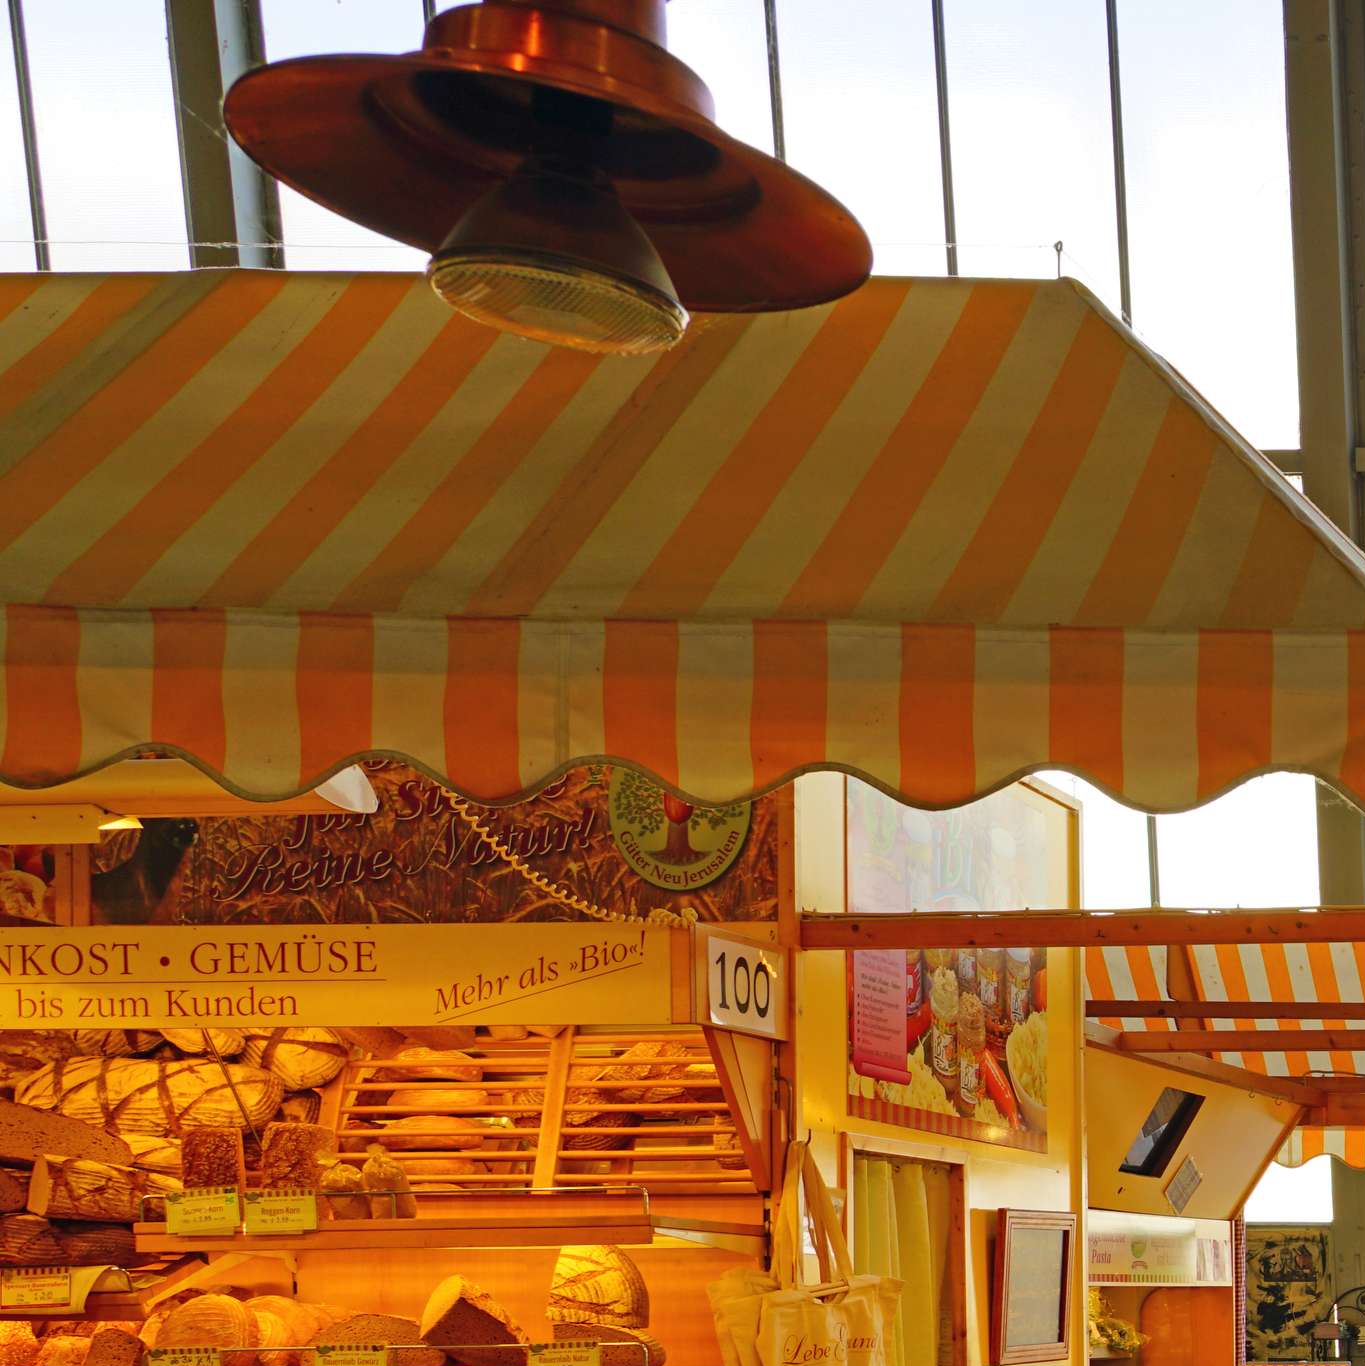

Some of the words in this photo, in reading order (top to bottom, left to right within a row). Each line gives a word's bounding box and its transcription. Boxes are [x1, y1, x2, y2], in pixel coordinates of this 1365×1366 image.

[211, 842, 394, 901] Reine
[403, 808, 596, 876] Natur!
[620, 831, 651, 871] Güter
[190, 934, 377, 974] GEMÜSE
[16, 989, 64, 1019] bis
[78, 994, 149, 1017] zum
[164, 987, 299, 1018] Kunden
[434, 973, 510, 1015] Mehr
[519, 957, 559, 989] als
[715, 951, 770, 1018] 100
